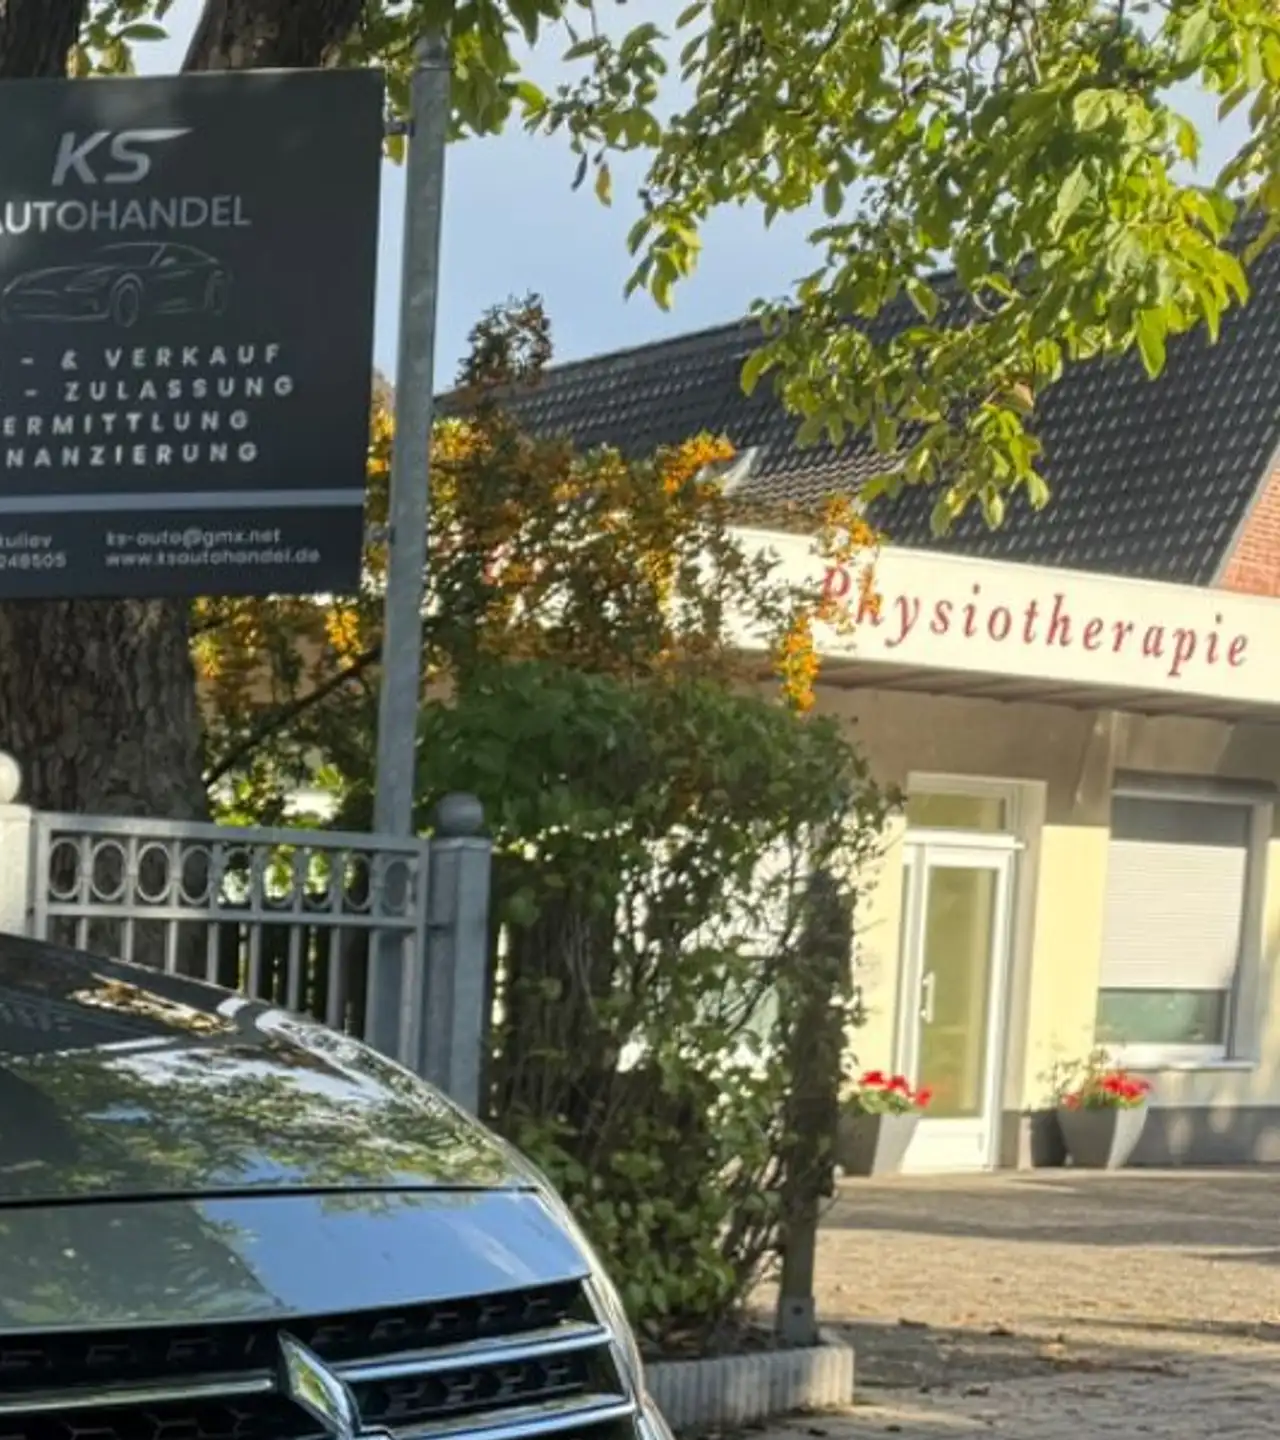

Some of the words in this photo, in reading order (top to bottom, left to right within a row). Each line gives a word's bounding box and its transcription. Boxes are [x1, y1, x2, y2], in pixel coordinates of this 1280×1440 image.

[51, 127, 194, 187] KS
[60, 350, 79, 370] &
[105, 343, 282, 369] VERKAUF
[63, 375, 295, 402] ZULASSUNG
